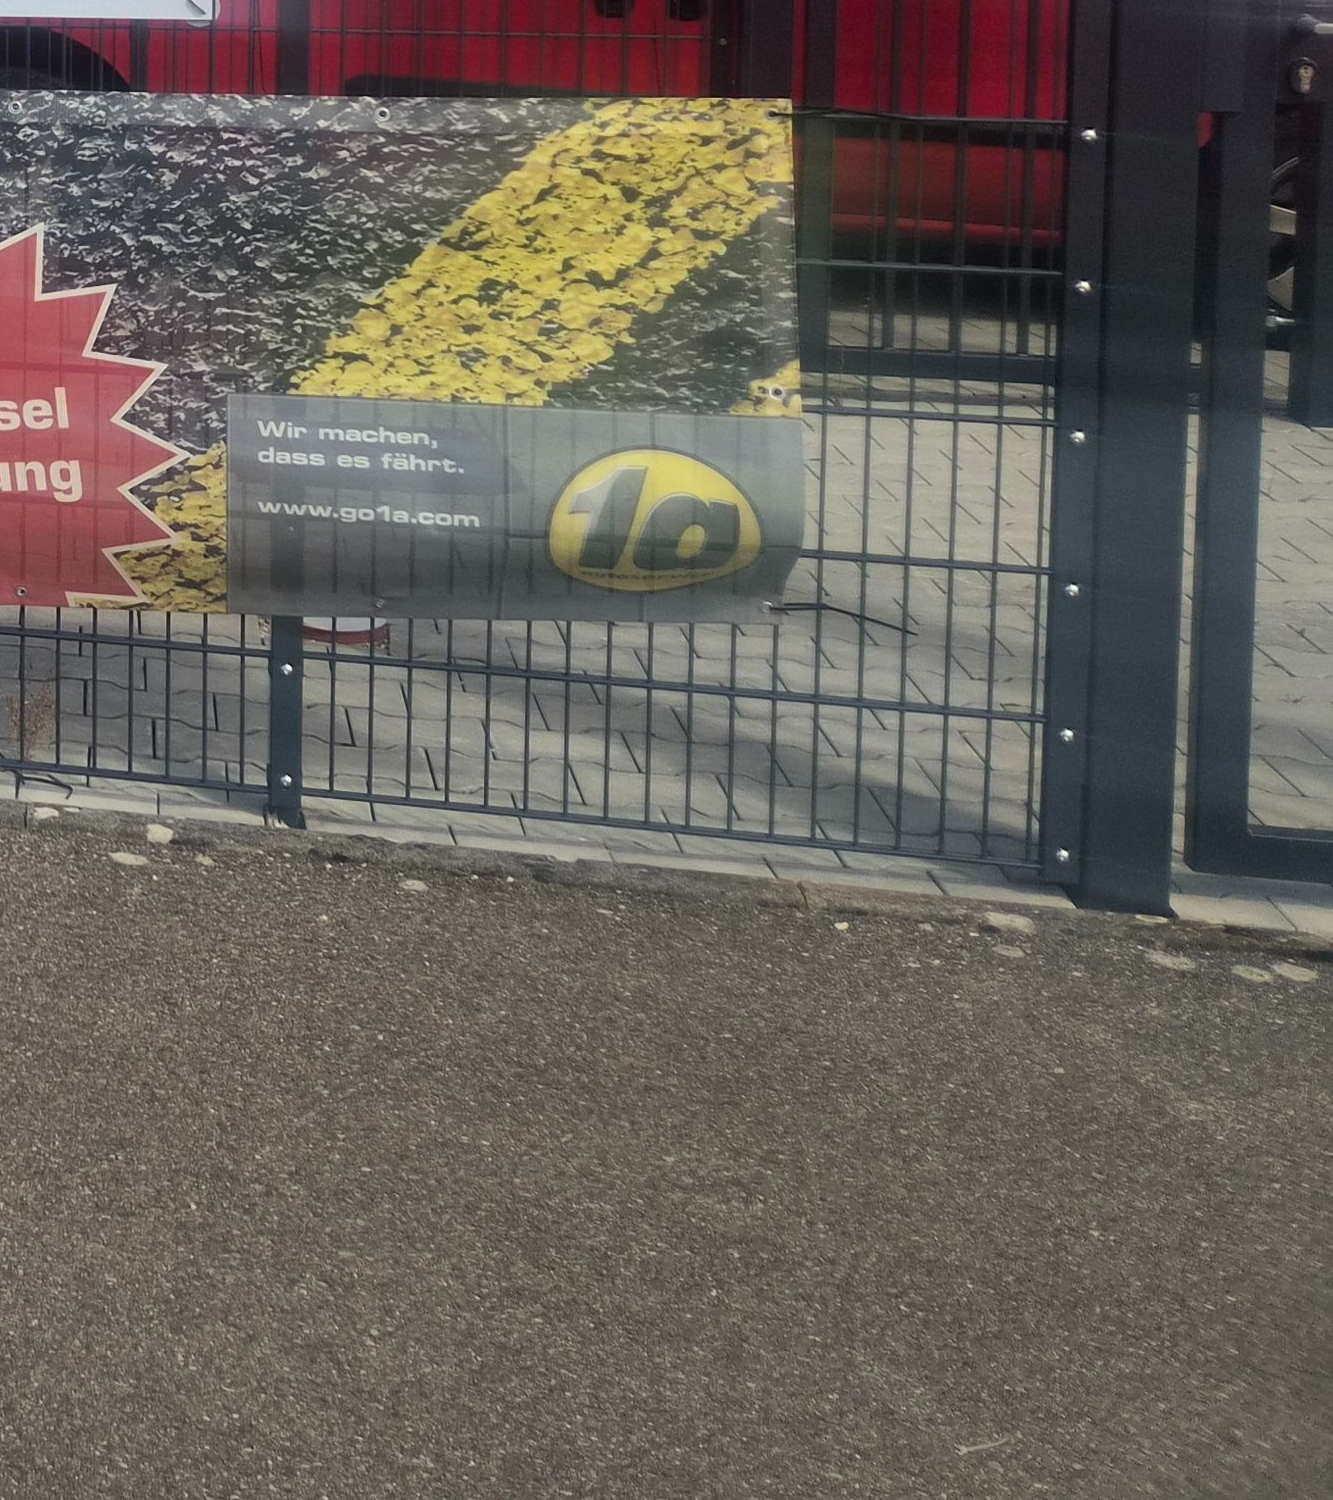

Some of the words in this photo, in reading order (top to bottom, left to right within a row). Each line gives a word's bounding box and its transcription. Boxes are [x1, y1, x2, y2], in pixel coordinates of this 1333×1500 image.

[257, 421, 307, 439] Wir
[319, 427, 438, 448] machen,
[258, 447, 325, 465] dass
[337, 455, 370, 468] es
[381, 454, 464, 474] fährt.
[258, 501, 480, 527] www.go1a.com
[568, 465, 741, 572] 1a
